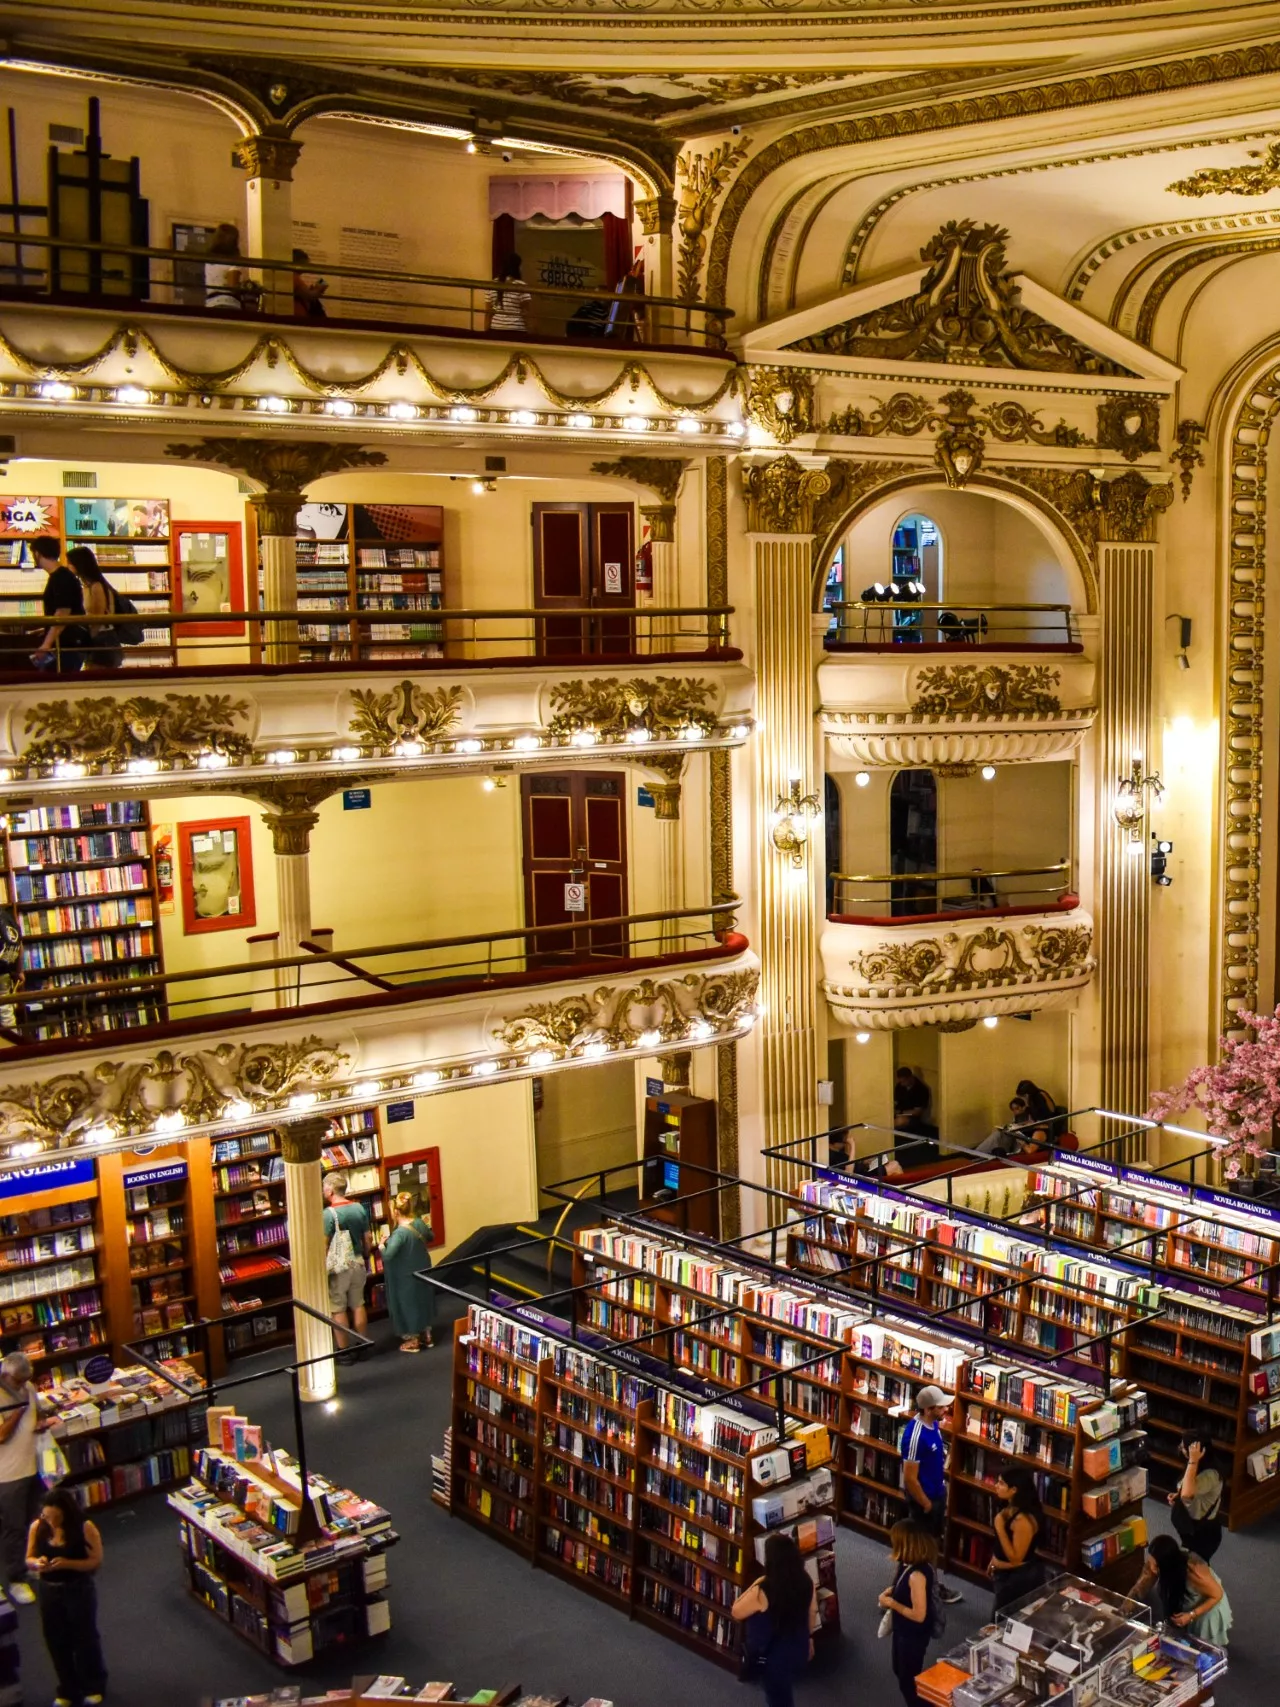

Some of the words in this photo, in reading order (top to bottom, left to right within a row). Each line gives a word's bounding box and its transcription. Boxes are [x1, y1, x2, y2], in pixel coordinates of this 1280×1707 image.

[79, 503, 93, 515] SPY
[75, 519, 98, 531] FAMILY
[1060, 1152, 1082, 1165] NOVELA
[127, 1173, 149, 1184] BOOKS
[149, 1172, 157, 1180] IN
[157, 1166, 183, 1178] ENGLISH
[1127, 1171, 1150, 1184] NOVELA
[1213, 1194, 1237, 1208] NOVELA
